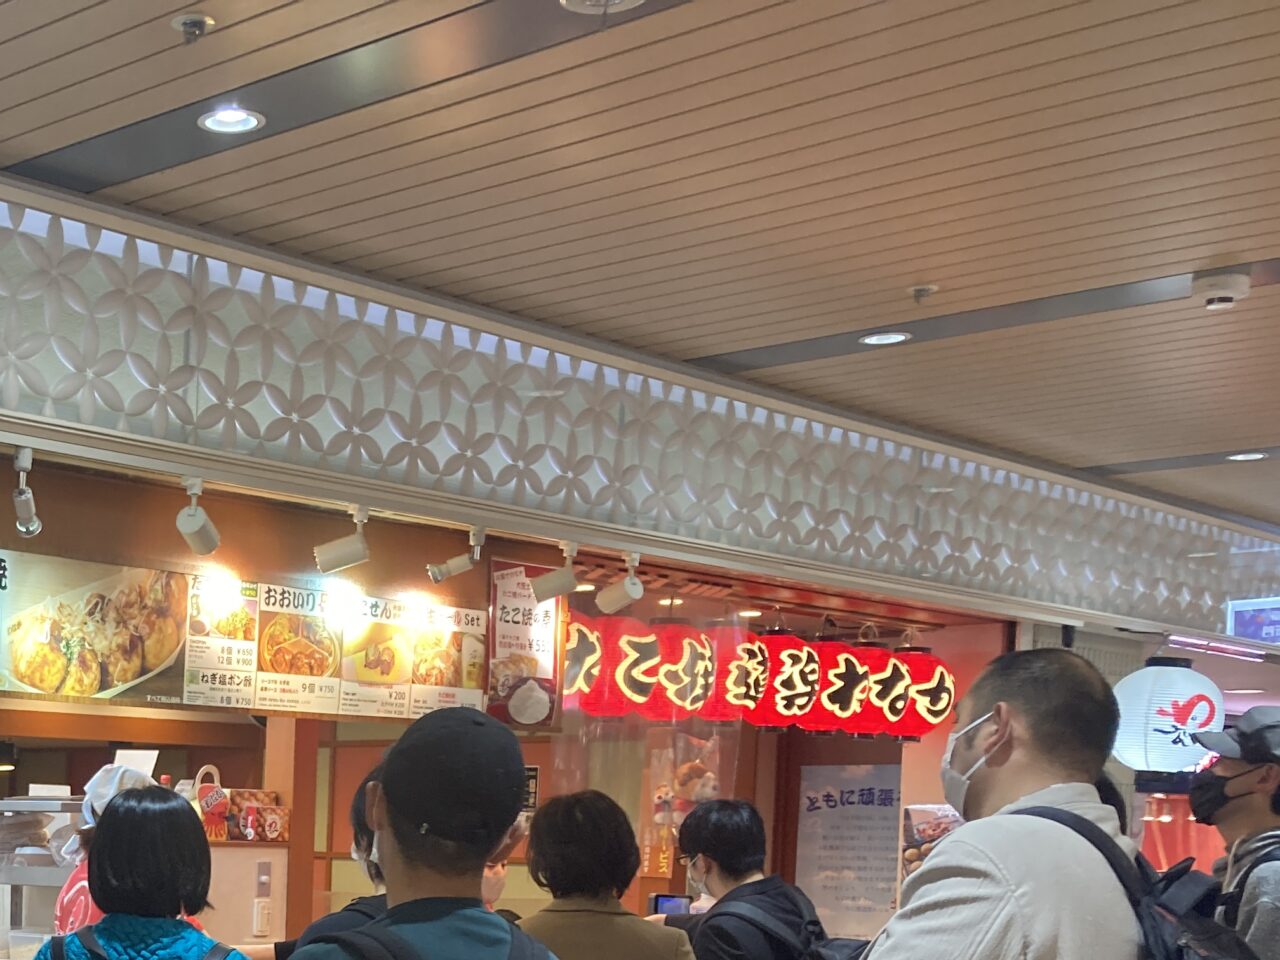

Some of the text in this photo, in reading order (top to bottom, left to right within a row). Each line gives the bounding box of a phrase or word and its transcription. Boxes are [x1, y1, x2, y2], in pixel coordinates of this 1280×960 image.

[805, 787, 901, 812] ともに頑張
